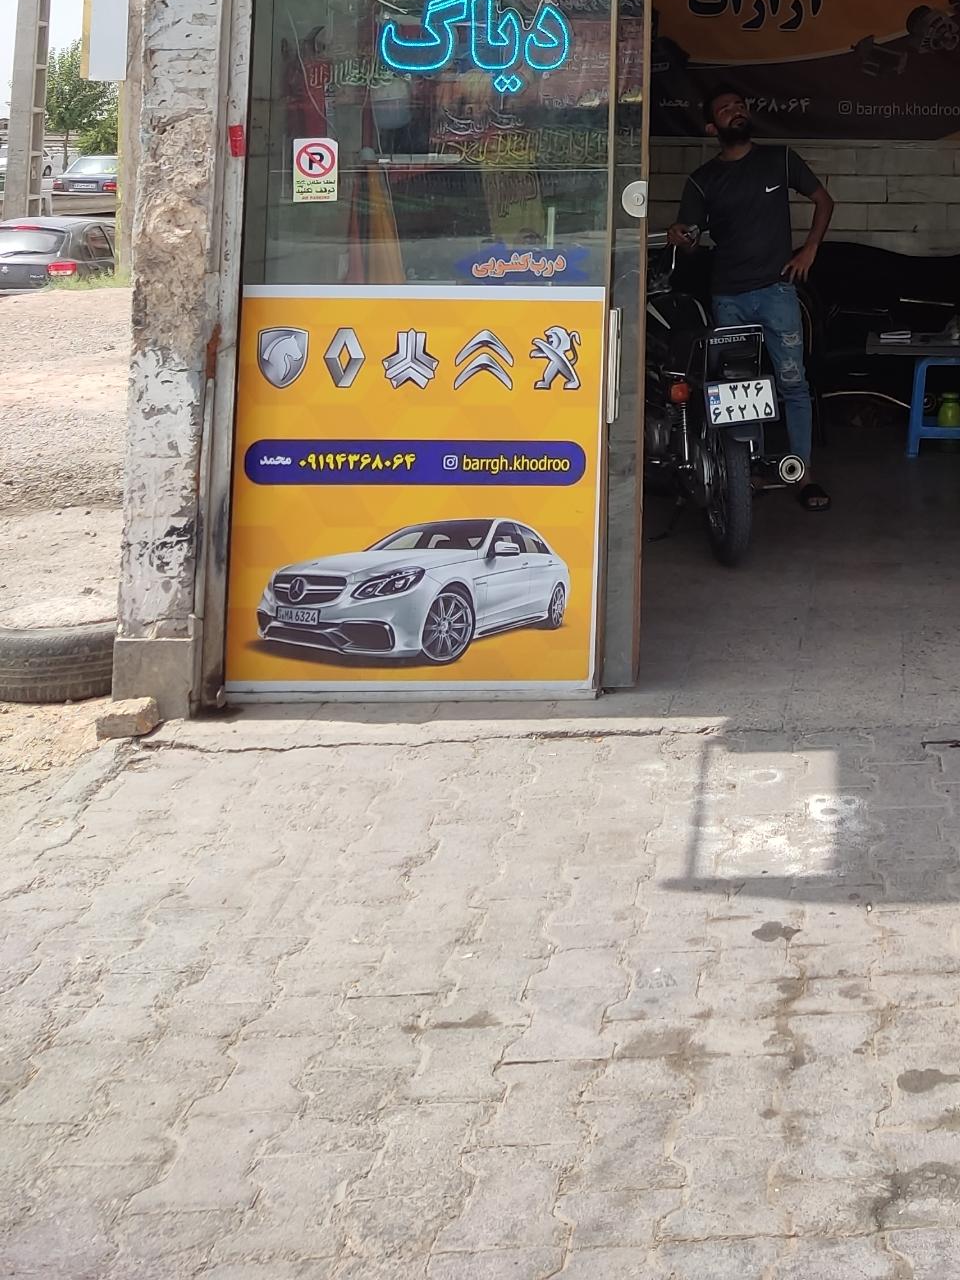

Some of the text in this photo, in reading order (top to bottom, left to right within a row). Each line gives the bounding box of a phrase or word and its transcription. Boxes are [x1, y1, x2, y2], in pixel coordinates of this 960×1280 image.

[856, 101, 960, 119] barrgh.khodroo
[530, 254, 566, 277] درب
[709, 335, 747, 345] HONDA
[729, 382, 763, 400] ۳۲۶
[712, 402, 773, 423] ۶۴۲۱۵
[259, 453, 416, 471] ۰۹۱۹۴۳۶۸۰۶۴ محمد
[462, 454, 571, 474] barrgh.khodroo
[295, 610, 316, 624] 6324
